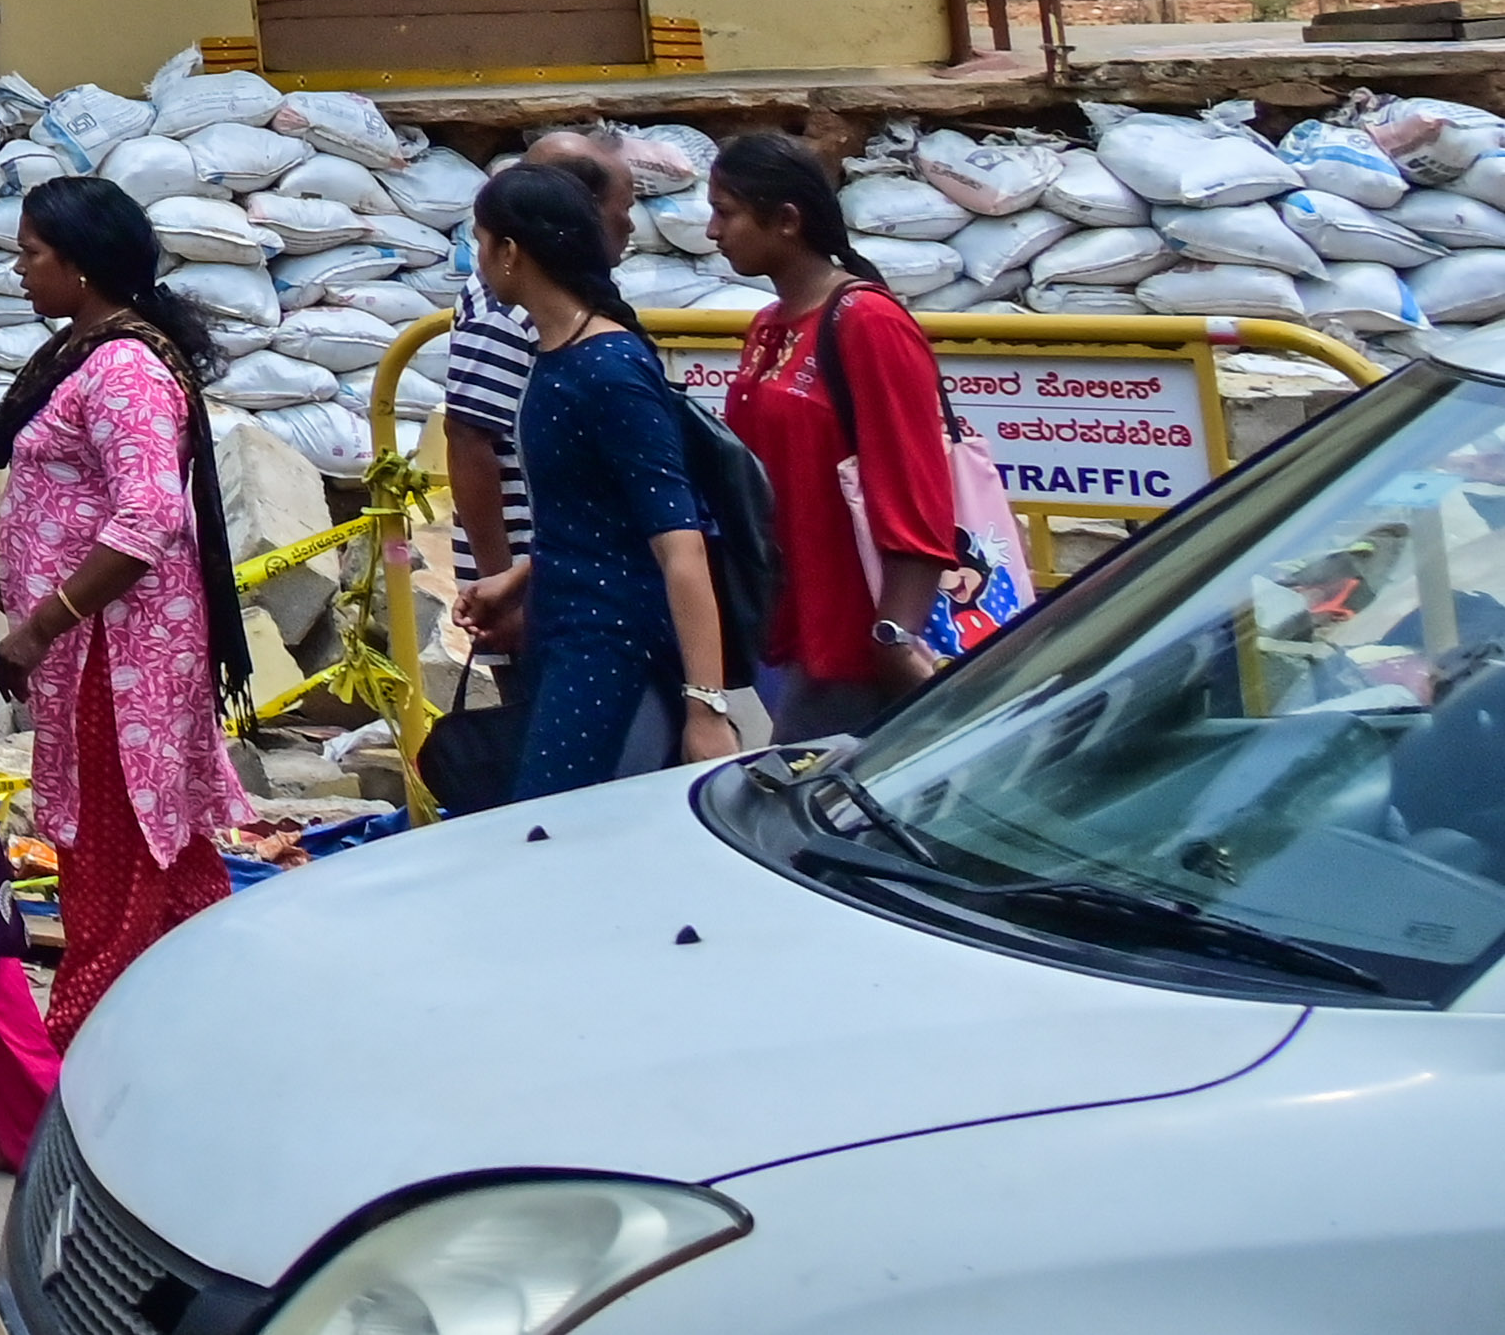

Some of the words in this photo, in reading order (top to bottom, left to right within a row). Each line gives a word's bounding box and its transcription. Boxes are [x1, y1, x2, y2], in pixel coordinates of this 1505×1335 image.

[1036, 371, 1161, 400] ಪೊಲೀಸ್
[997, 416, 1193, 448] ಆತುರಪಡಬೇಡಿ
[994, 462, 1172, 498] TRAFFIC
